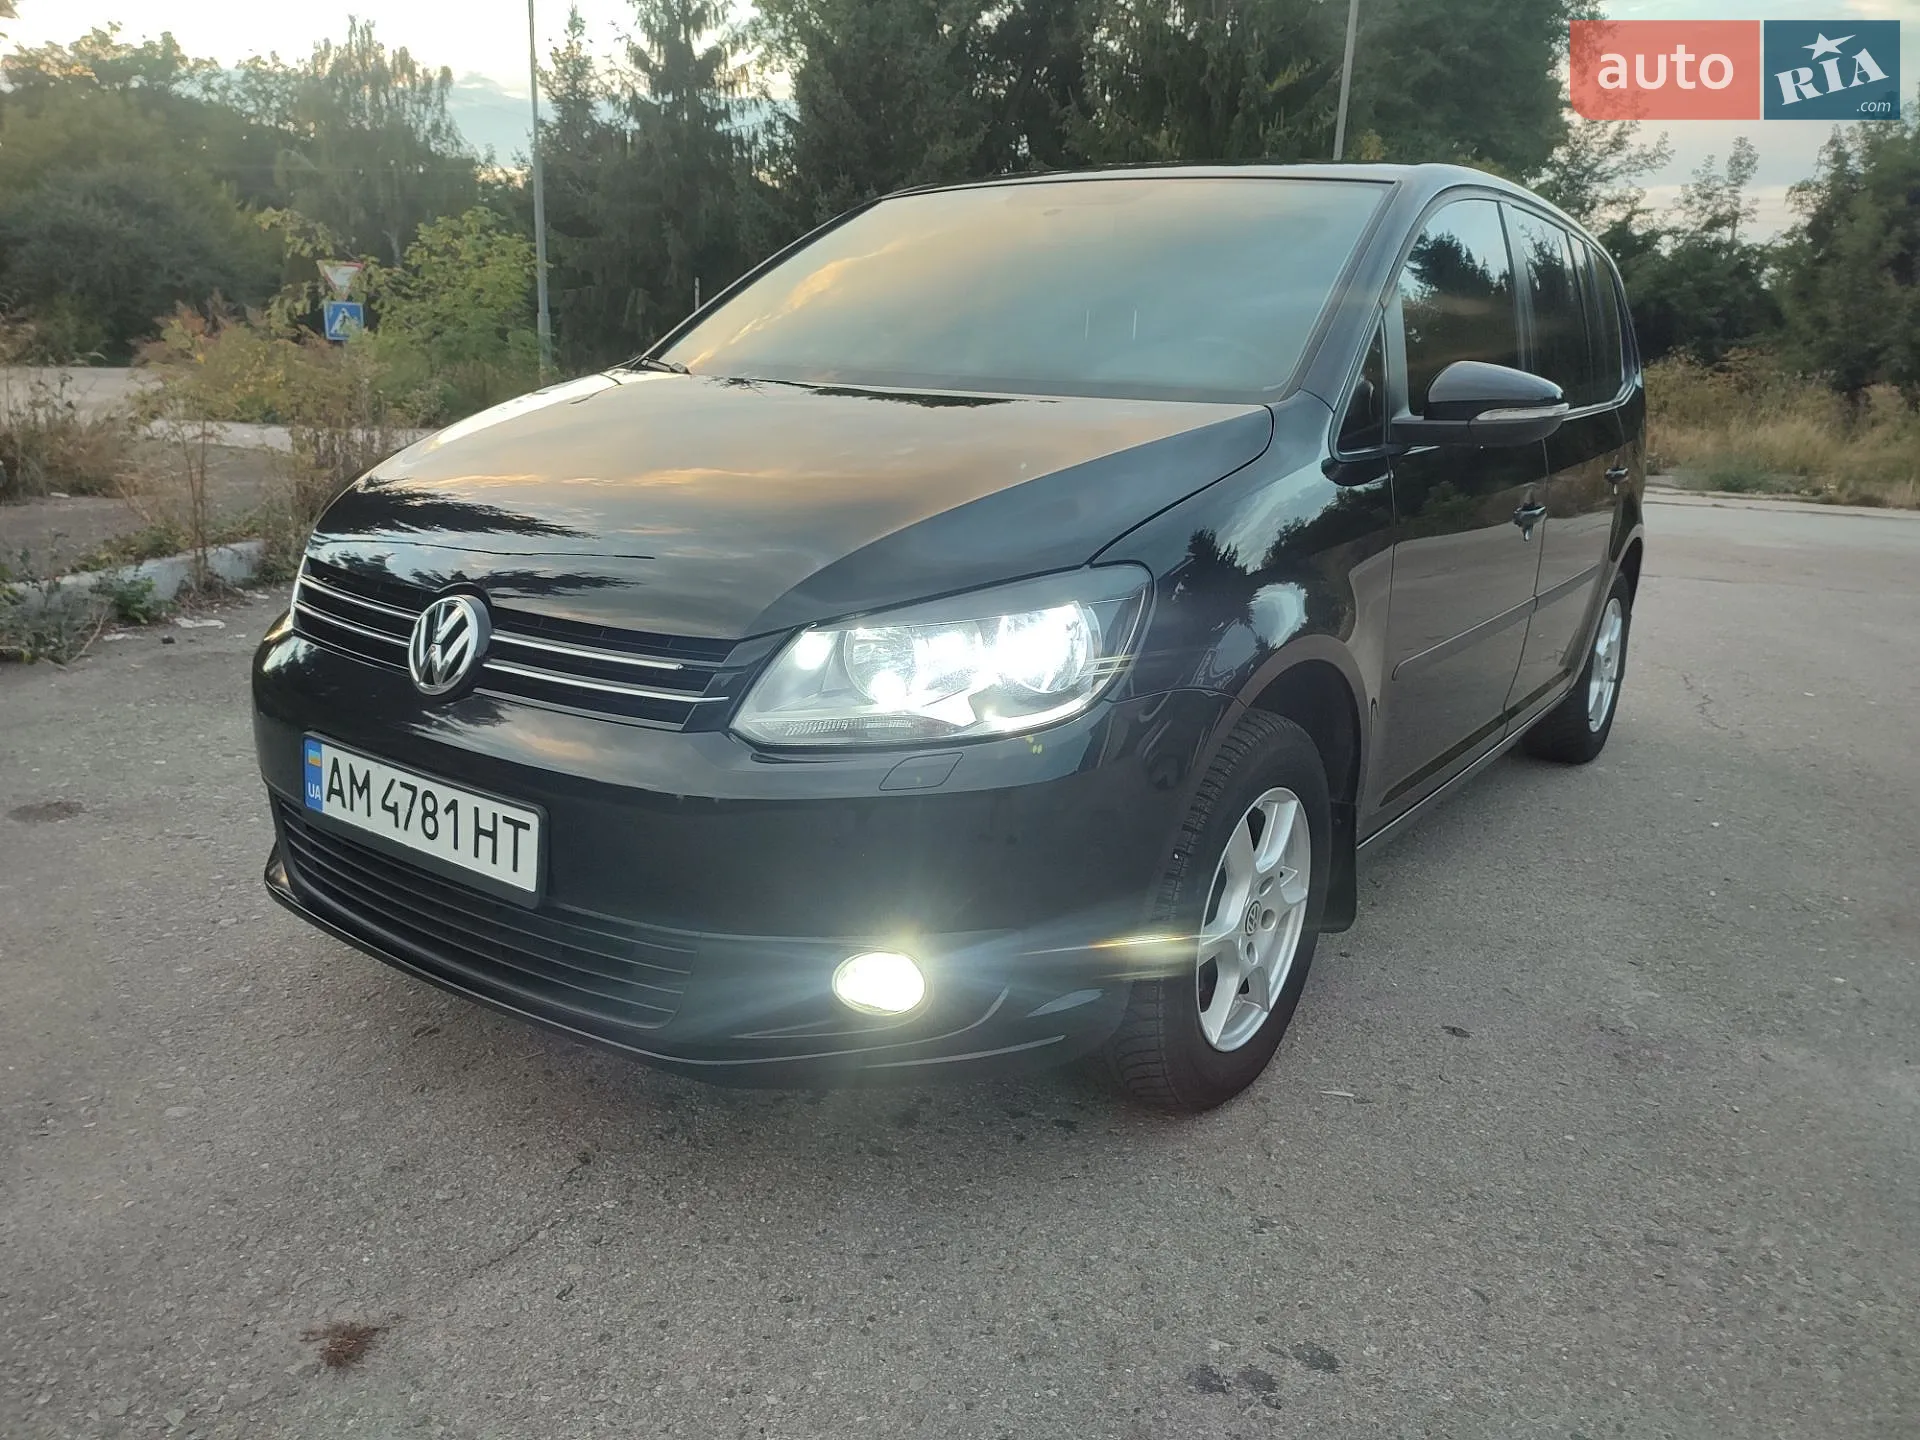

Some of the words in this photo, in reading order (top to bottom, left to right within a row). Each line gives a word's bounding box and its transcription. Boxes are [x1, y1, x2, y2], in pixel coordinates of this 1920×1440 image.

[409, 596, 478, 695] VW
[308, 782, 321, 800] UA
[326, 757, 371, 818] AM
[381, 778, 459, 850] 4781
[474, 806, 531, 873] HT
